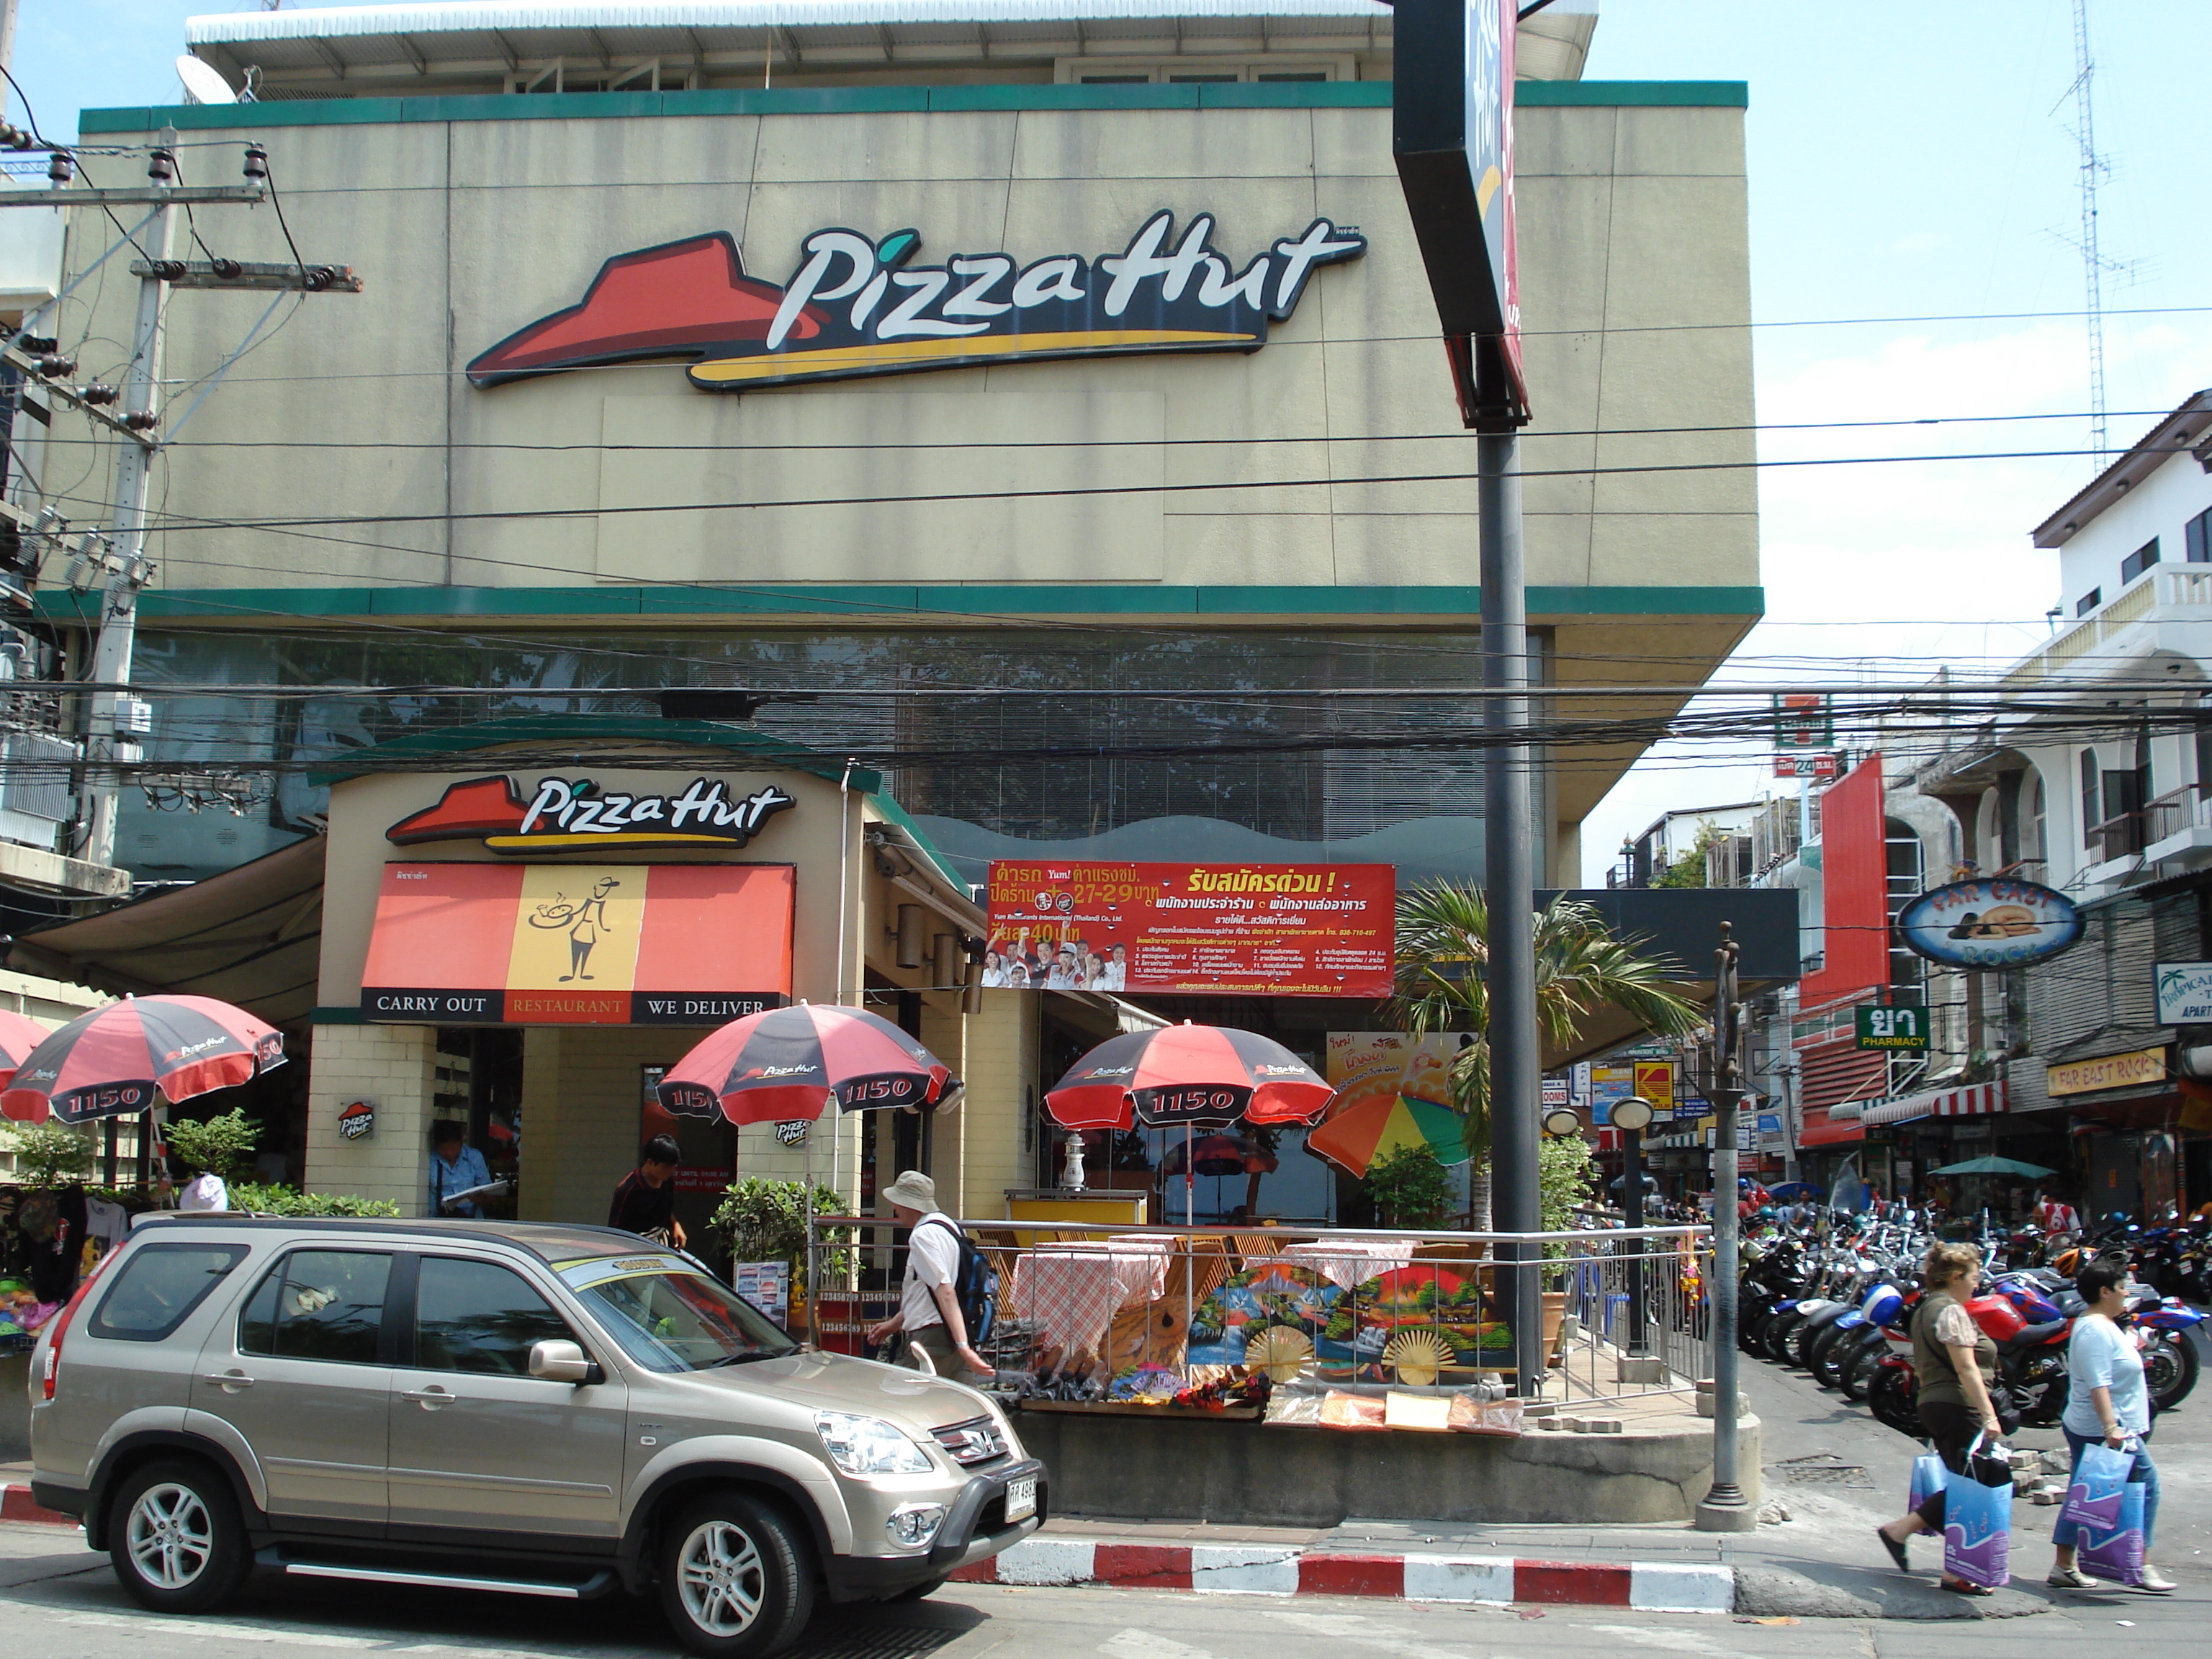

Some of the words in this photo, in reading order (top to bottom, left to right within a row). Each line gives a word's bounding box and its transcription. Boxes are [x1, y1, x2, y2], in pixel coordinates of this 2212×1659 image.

[766, 230, 1085, 350] Pizza
[1097, 212, 1362, 313] Hut
[1795, 760, 1814, 773] 24
[519, 780, 665, 834] Pizza
[669, 778, 788, 828] Hut
[1048, 869, 1071, 881] Yum!
[1187, 868, 1321, 893] รับสมัครด่วน
[1156, 895, 1254, 910] พนักงานประจำร้าน
[1269, 896, 1367, 911] พนักงานส่งอาหาร
[1930, 885, 1979, 912] FAR
[1991, 882, 2054, 909] EAST
[377, 996, 437, 1012] CARRY
[446, 996, 486, 1013] OUT
[512, 998, 624, 1013] RESTAURANT
[647, 999, 680, 1015] WE
[684, 1000, 765, 1016] DELIVER
[1870, 1009, 1916, 1037] ยา
[1863, 1035, 1926, 1047] PHARMACY
[763, 1066, 794, 1077] Pizza
[793, 1063, 818, 1073] Hut
[2059, 1069, 2080, 1089] FAR
[2082, 1063, 2113, 1085] EAST
[2117, 1057, 2150, 1080] ROCK
[69, 1087, 141, 1114] 1150
[845, 1079, 913, 1105] 1150
[1152, 1090, 1234, 1114] 1150
[341, 1113, 373, 1134] Pizza
[346, 1122, 370, 1138] Hut
[783, 1129, 806, 1143] Hut
[822, 1322, 861, 1333] 12345689
